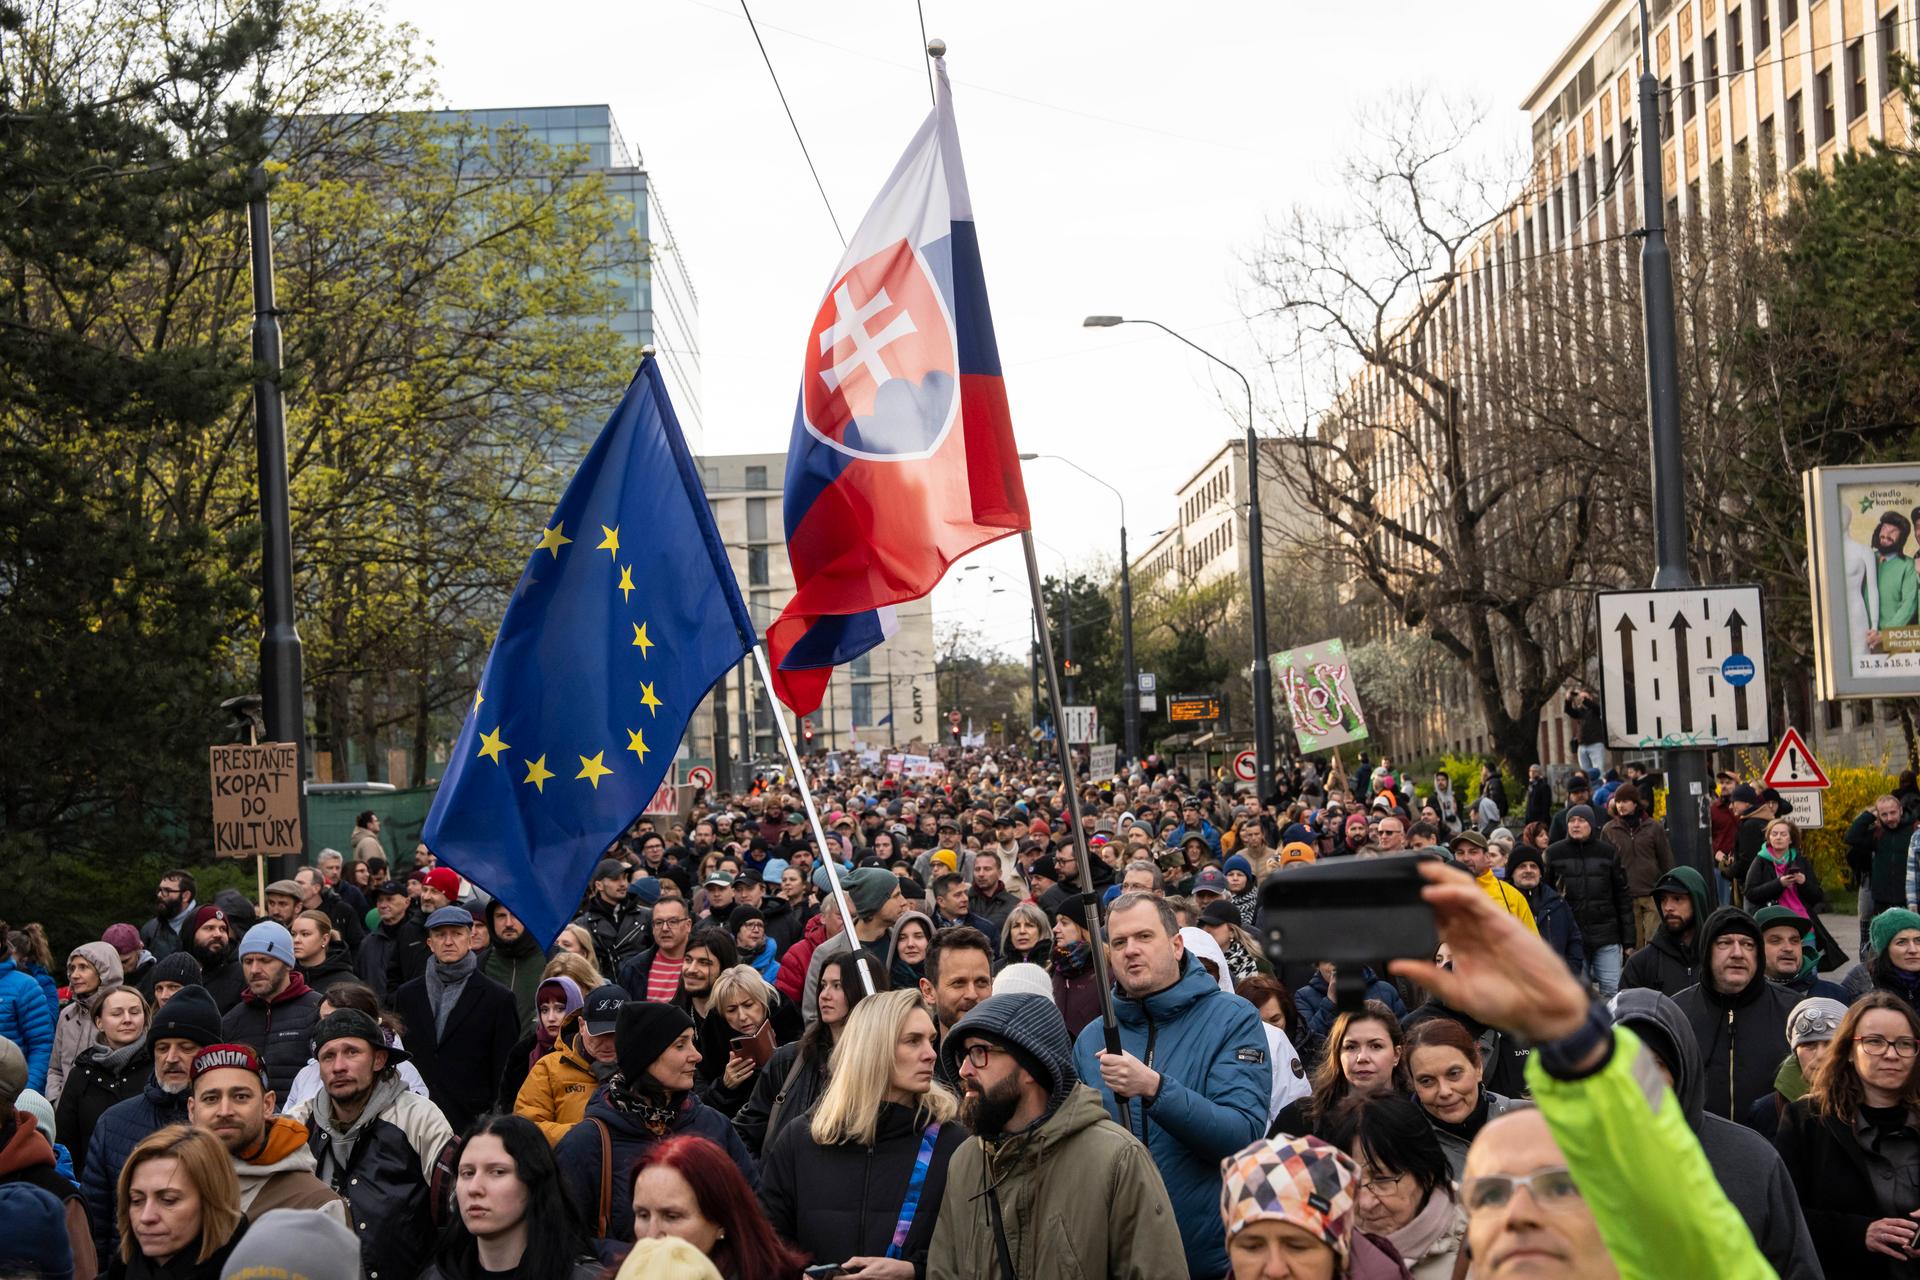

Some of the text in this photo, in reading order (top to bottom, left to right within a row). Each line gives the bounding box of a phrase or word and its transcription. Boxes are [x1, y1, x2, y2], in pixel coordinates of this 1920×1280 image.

[1870, 490, 1901, 498] divadlo
[912, 686, 923, 724] CARTY
[213, 748, 295, 772] PRESTAŇTE
[241, 797, 266, 817] DO
[216, 815, 297, 851] KULTÚRY
